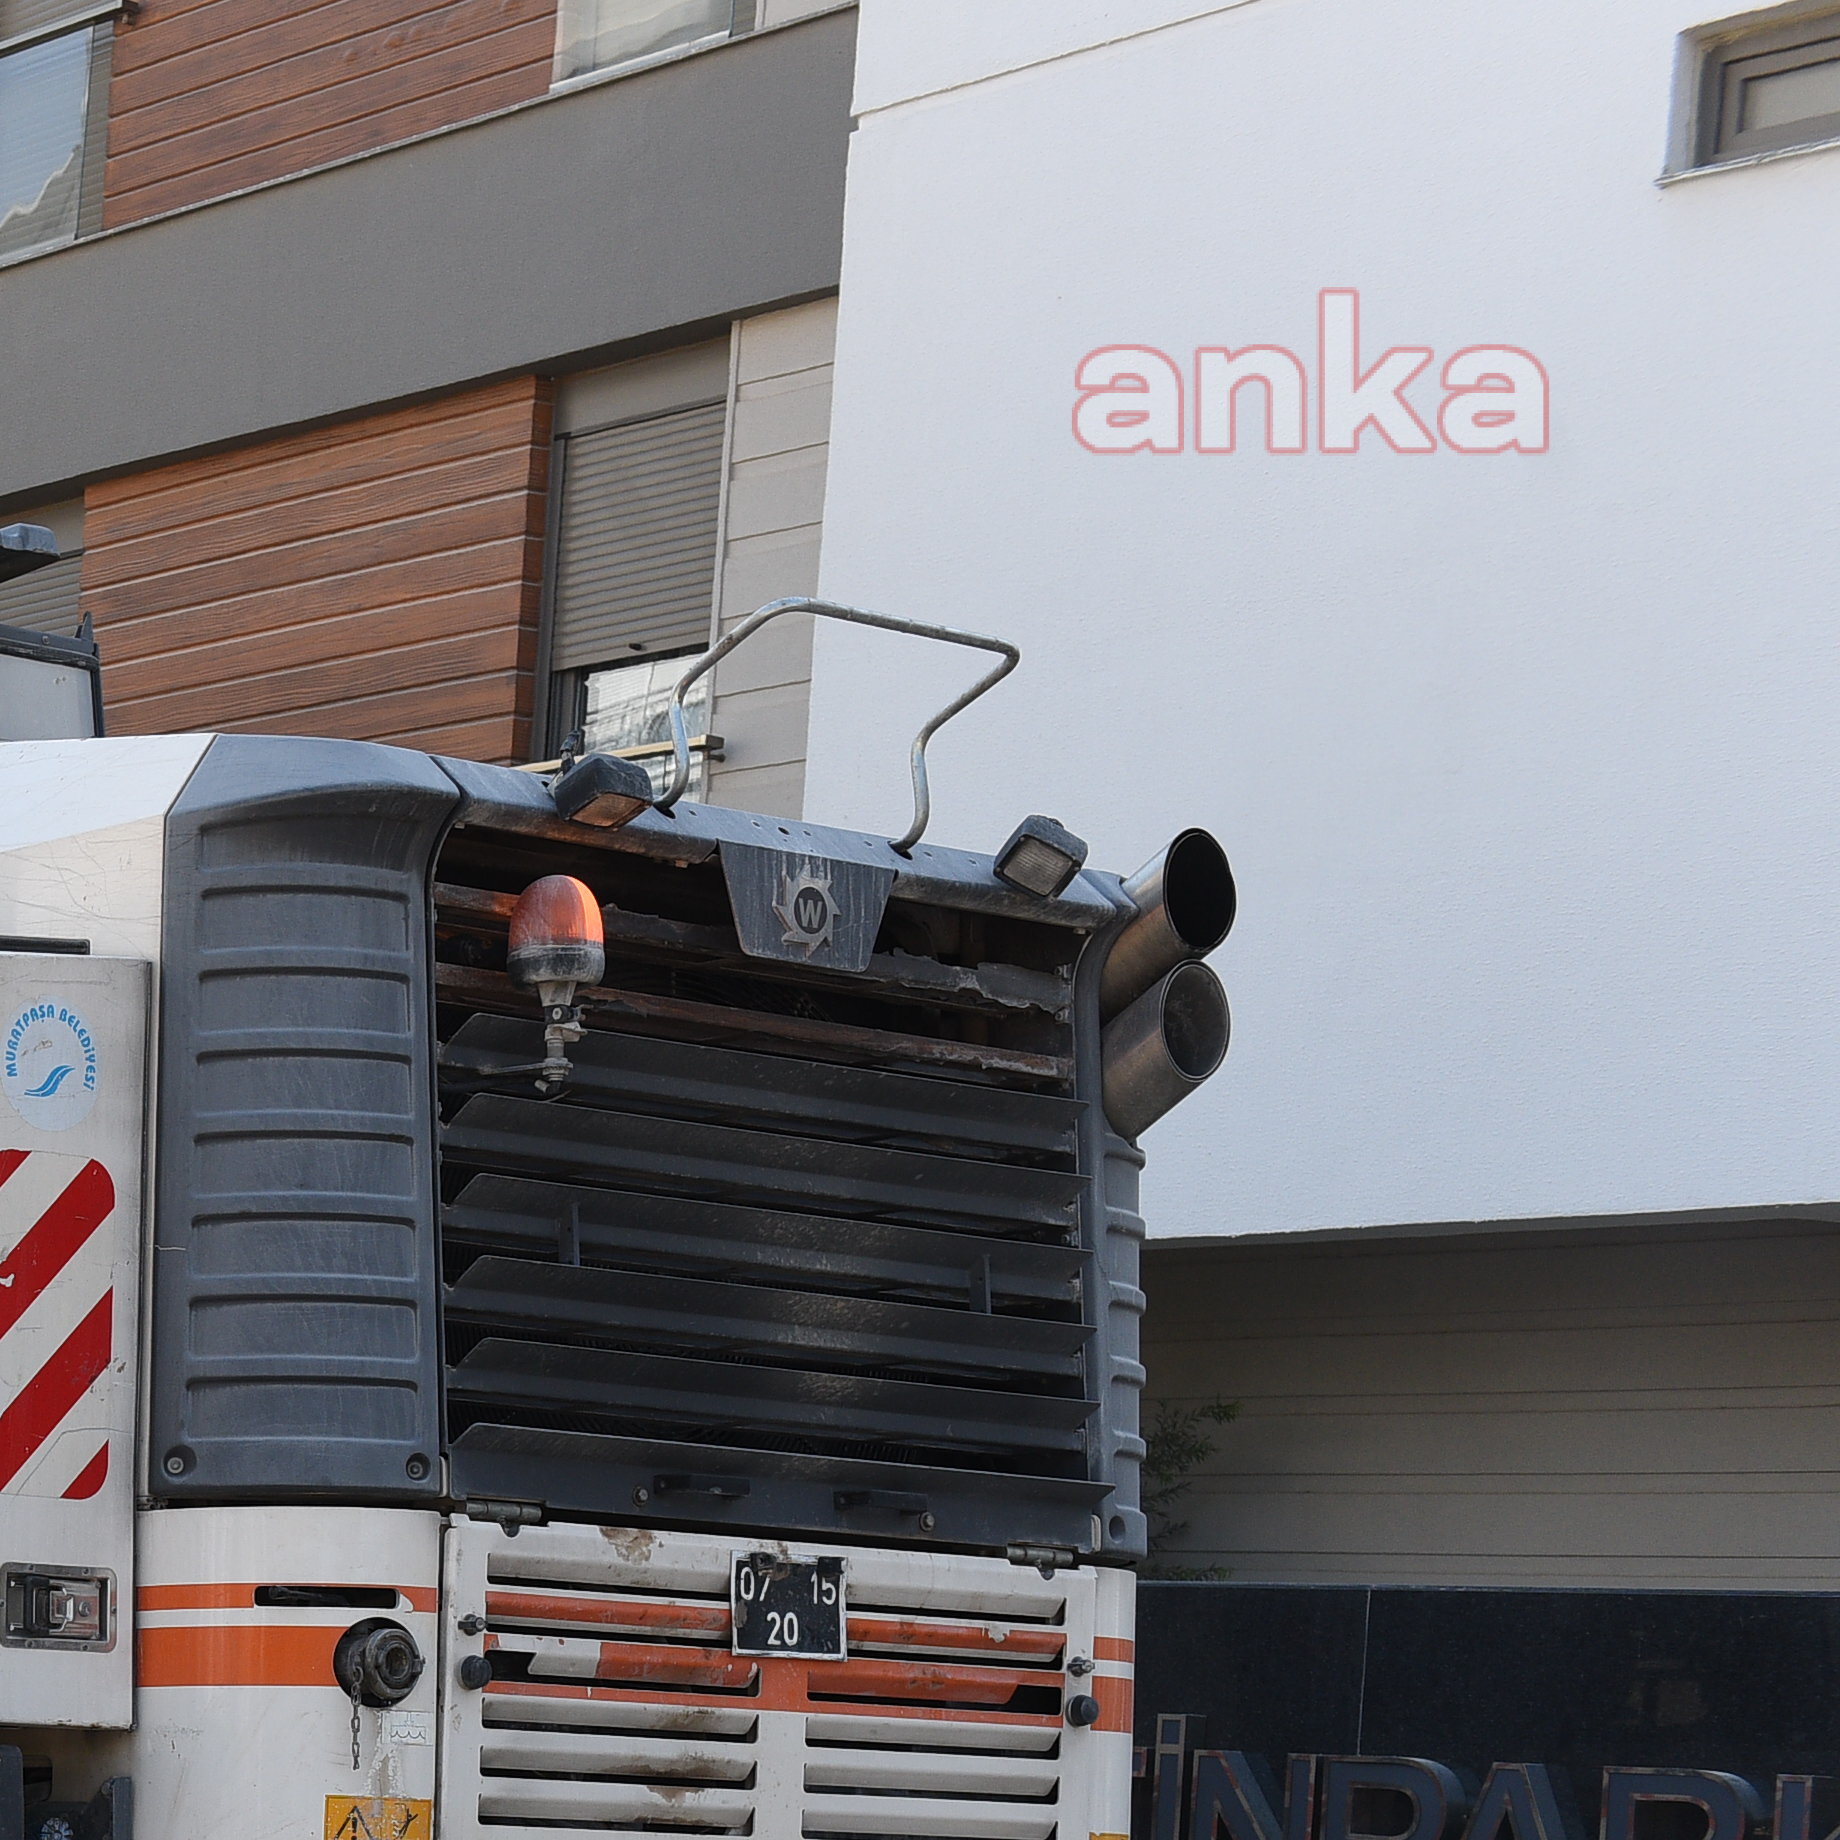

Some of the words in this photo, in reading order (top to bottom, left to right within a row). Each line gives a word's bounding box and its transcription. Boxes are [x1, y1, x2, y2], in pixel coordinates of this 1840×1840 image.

[5, 1004, 55, 1078] MURATPAŞA
[58, 1008, 97, 1091] BELEDİYESİ
[766, 1611, 799, 1647] 20
